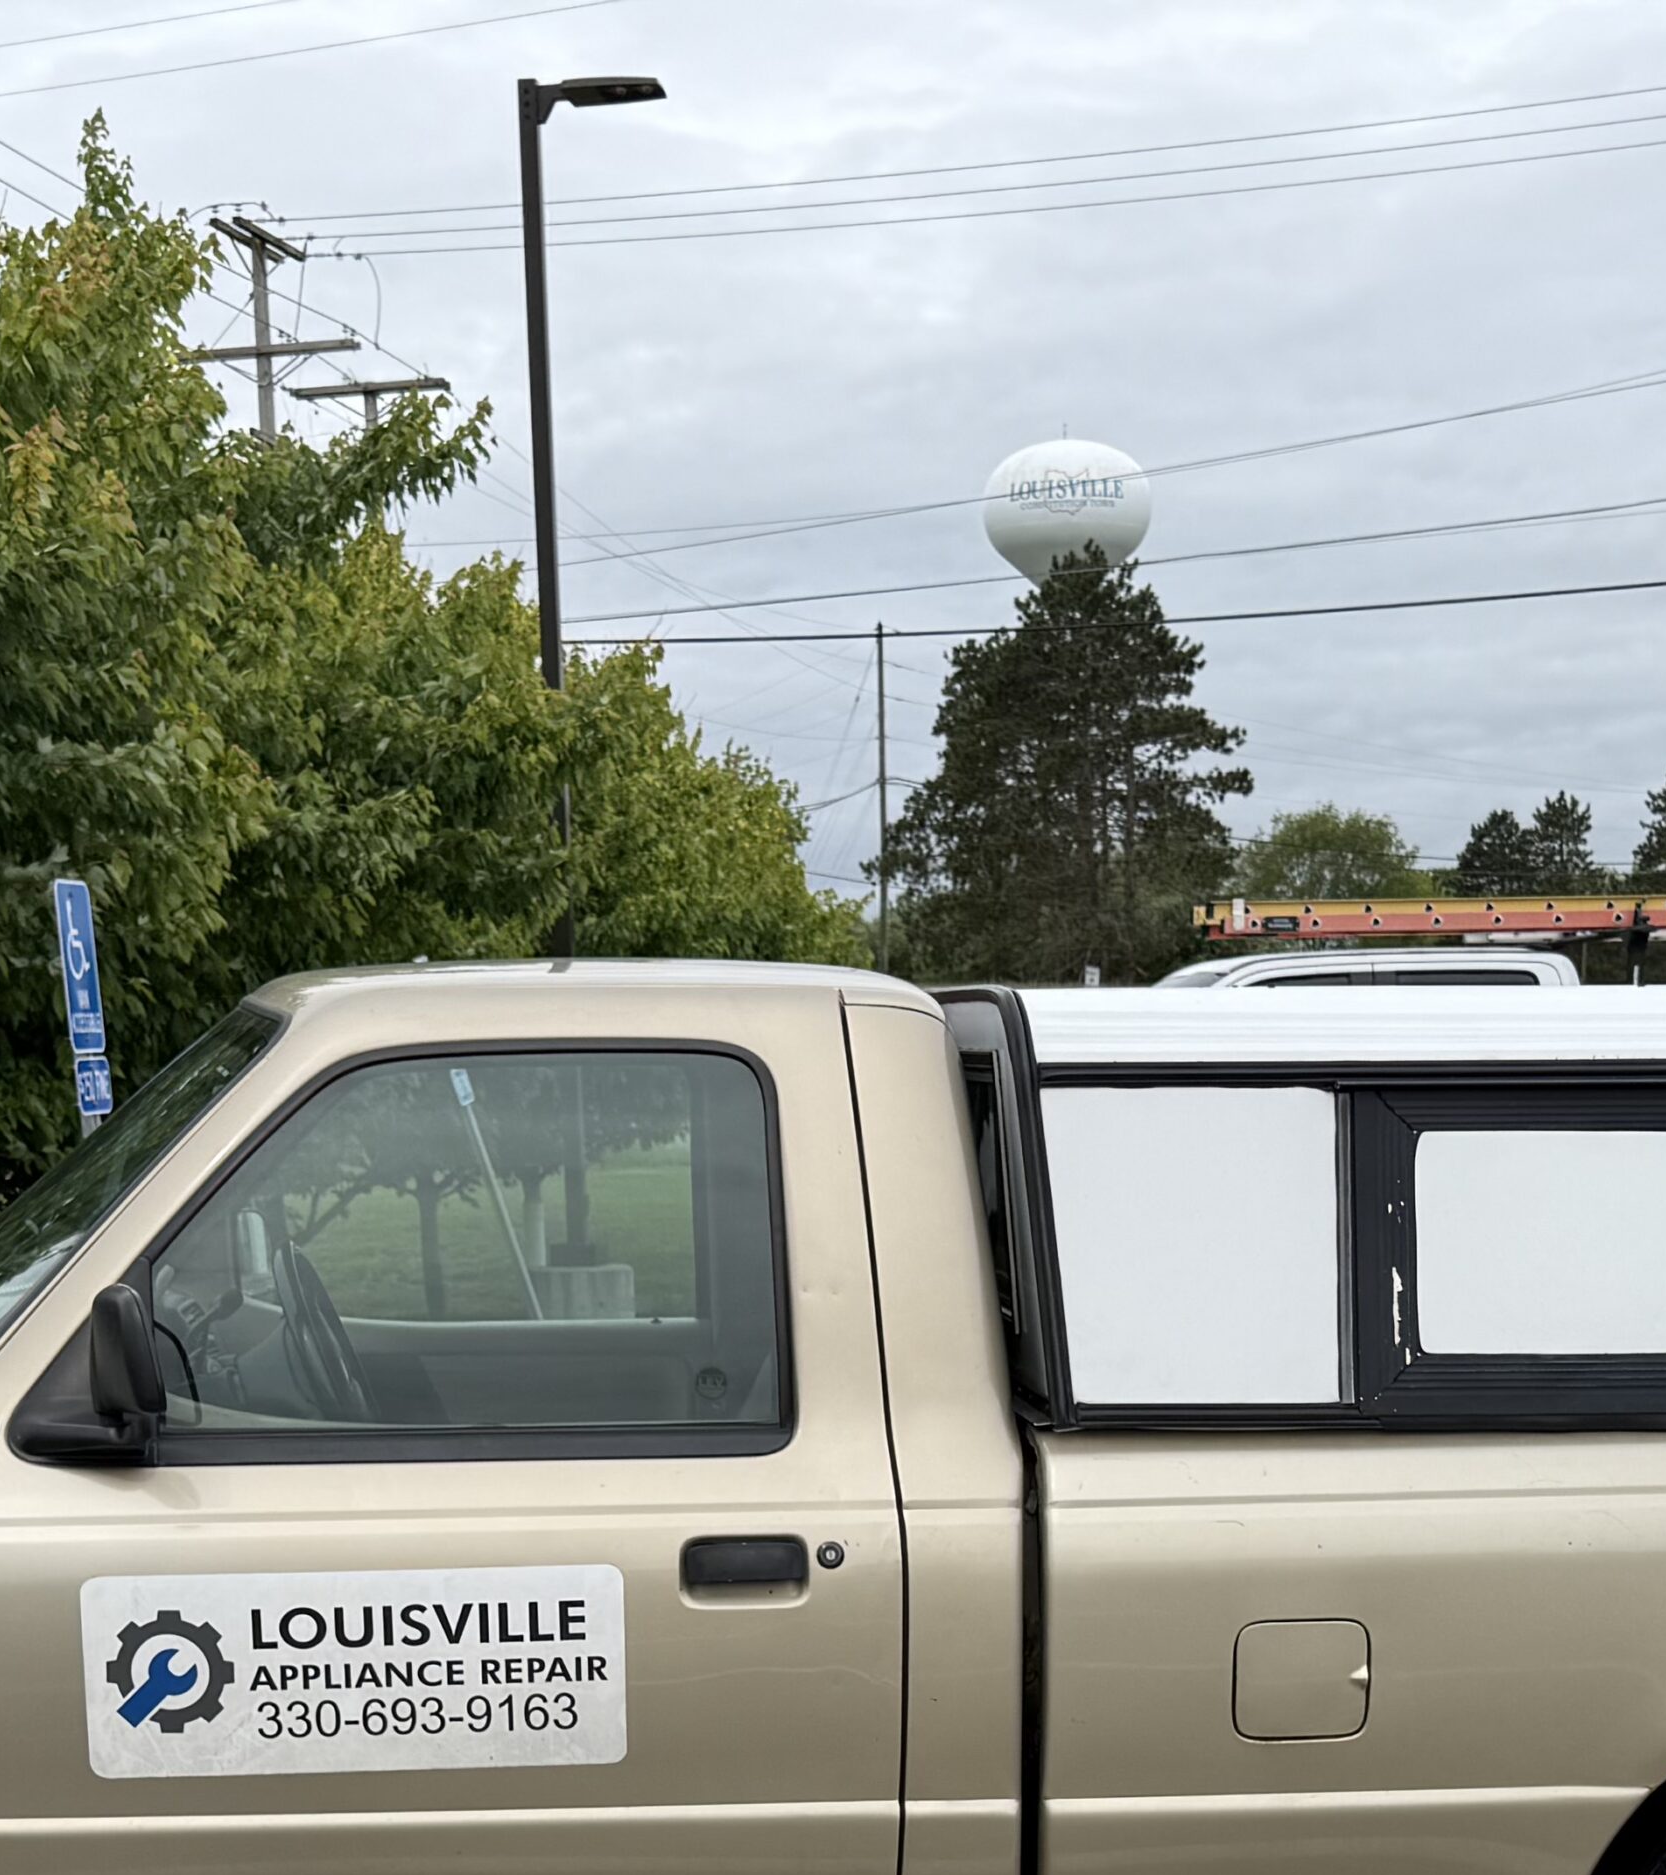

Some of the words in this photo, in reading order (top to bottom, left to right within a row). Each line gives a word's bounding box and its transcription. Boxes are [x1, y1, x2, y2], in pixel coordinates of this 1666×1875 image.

[1009, 479, 1125, 502] LOUISVILLE
[249, 1599, 587, 1651] LOUISVILLE
[248, 1659, 466, 1693] APPLIANCE
[479, 1655, 609, 1686] REPAIR
[256, 1691, 580, 1741] 330-693-9163
